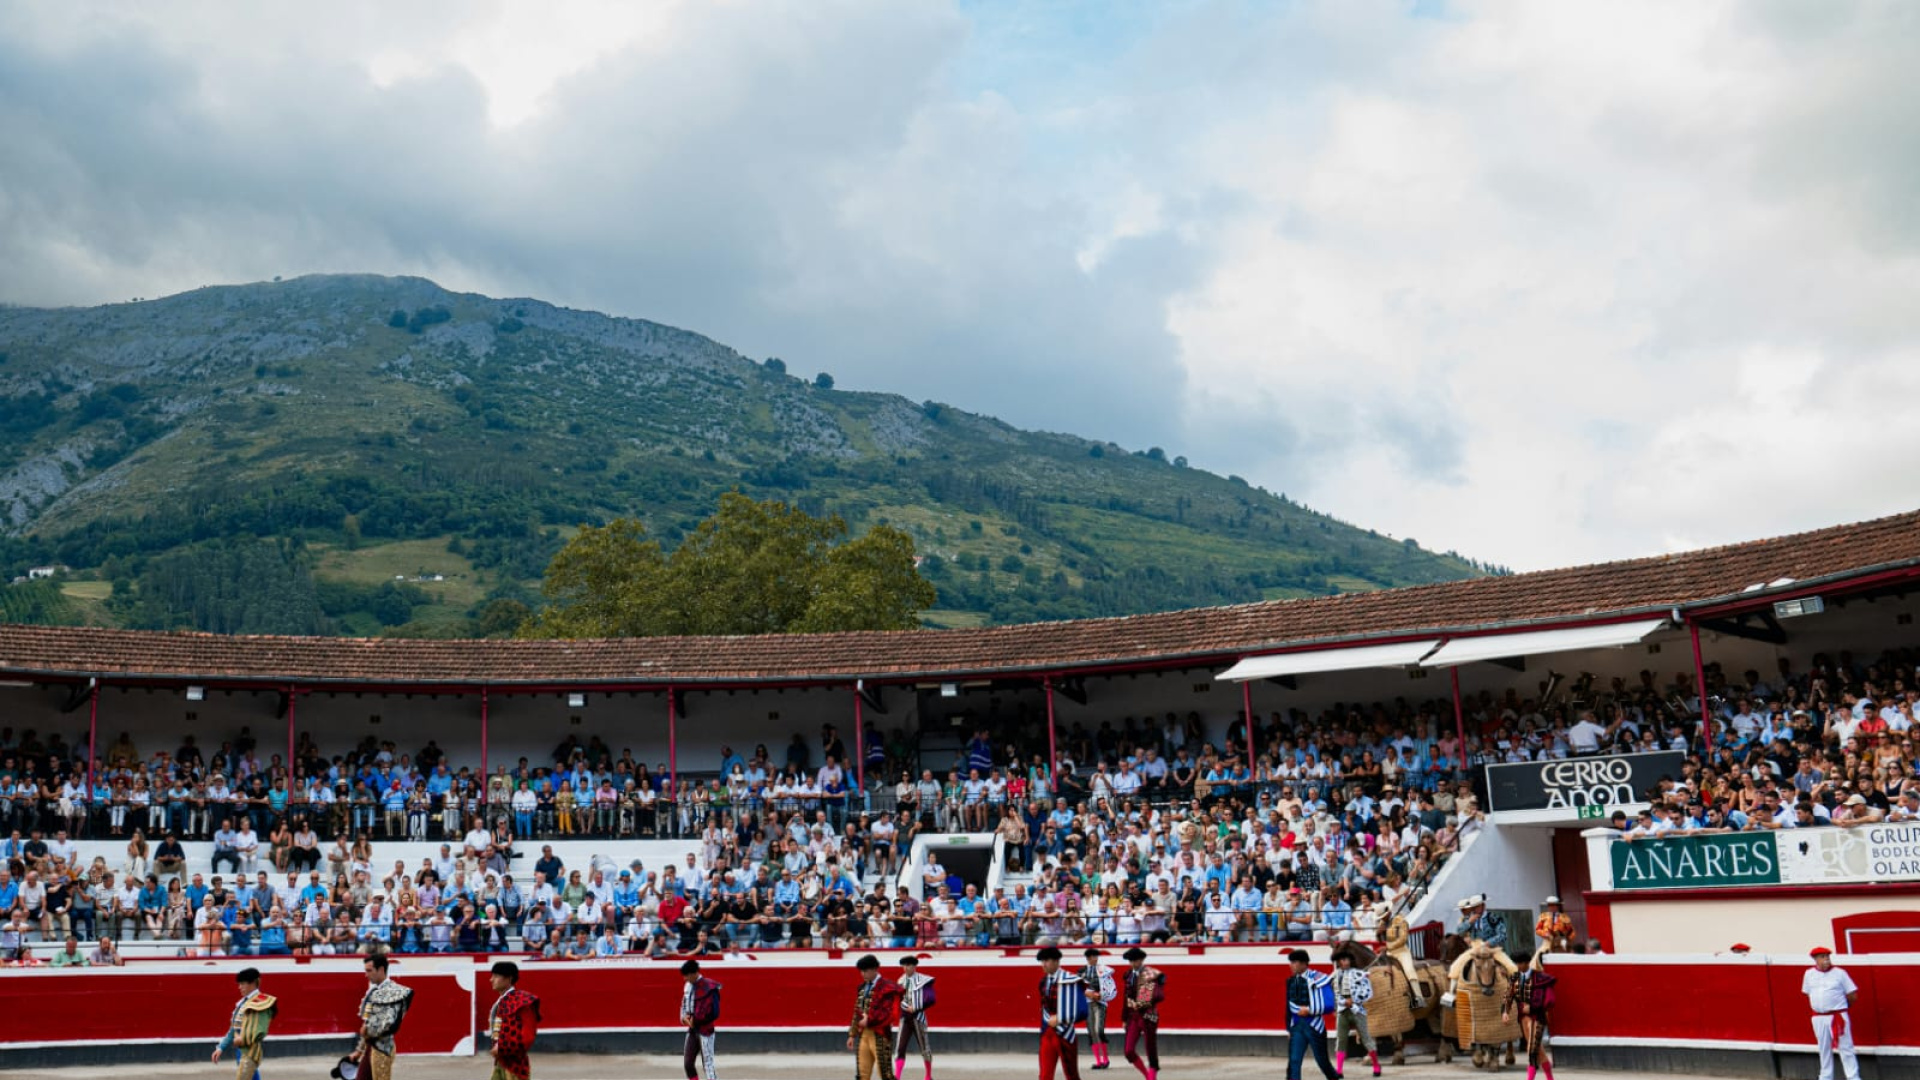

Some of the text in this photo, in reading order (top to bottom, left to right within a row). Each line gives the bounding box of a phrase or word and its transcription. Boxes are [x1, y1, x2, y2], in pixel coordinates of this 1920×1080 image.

[1541, 758, 1632, 786] CERRO
[1620, 841, 1772, 881] AÑARES
[1874, 861, 1920, 875] OLAR
